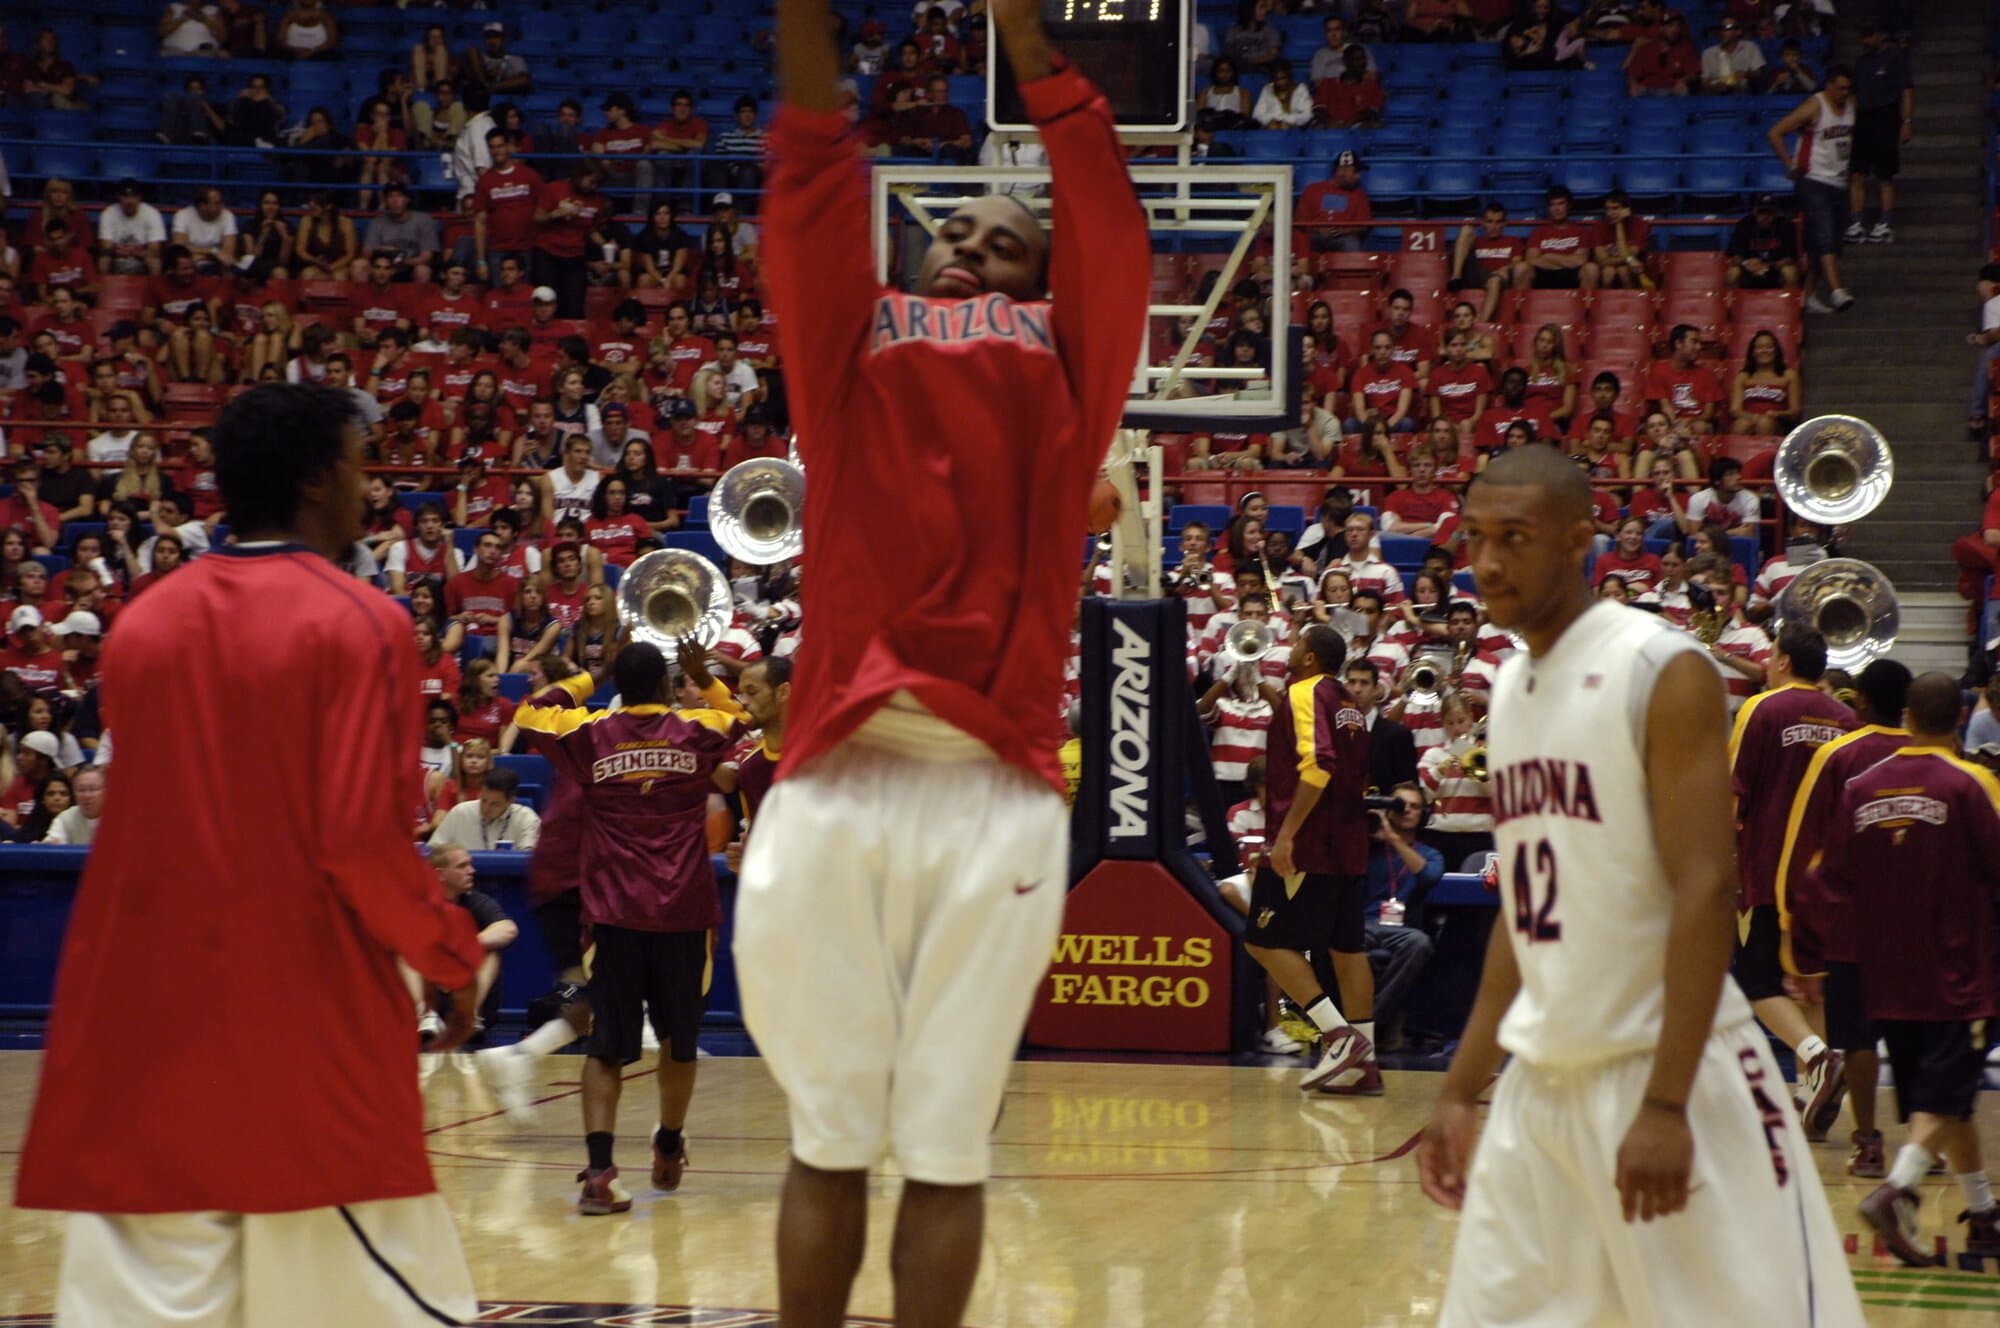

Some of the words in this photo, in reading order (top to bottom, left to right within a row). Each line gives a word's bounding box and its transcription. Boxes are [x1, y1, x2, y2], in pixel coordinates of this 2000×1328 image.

[1410, 232, 1436, 250] 21
[870, 293, 1055, 355] ARIZON
[1109, 617, 1150, 837] ARIZONA
[592, 749, 697, 784] STINGERS
[1512, 837, 1562, 942] 42
[1051, 934, 1213, 968] WELLS
[1049, 974, 1210, 1008] FARGO
